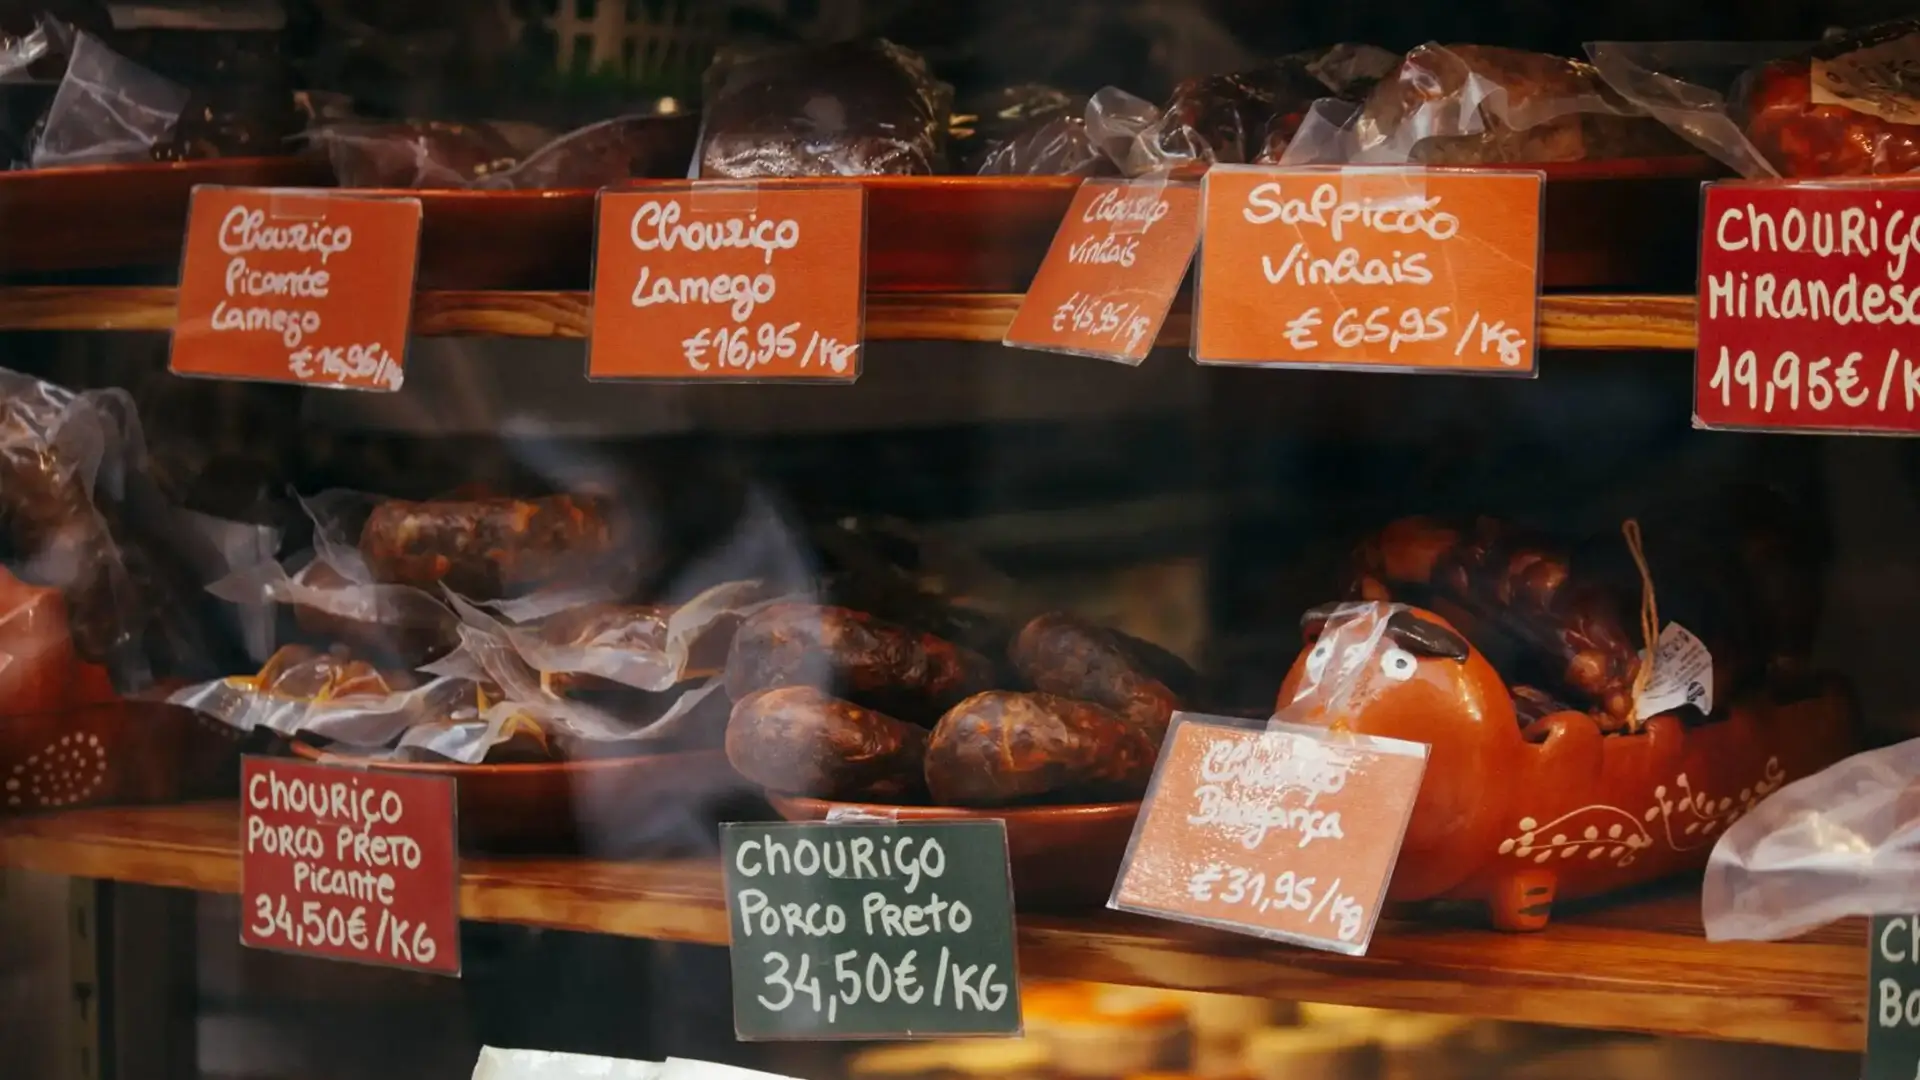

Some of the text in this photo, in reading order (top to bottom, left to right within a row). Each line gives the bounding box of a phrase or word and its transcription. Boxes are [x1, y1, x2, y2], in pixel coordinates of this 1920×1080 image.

[218, 205, 352, 265] Chouriço
[630, 200, 800, 265] Chouriço
[225, 257, 330, 298] Picante
[1261, 243, 1433, 286] Vinhais
[630, 266, 776, 322] Lamego
[211, 301, 321, 347] Lamego
[293, 861, 396, 906] Picante
